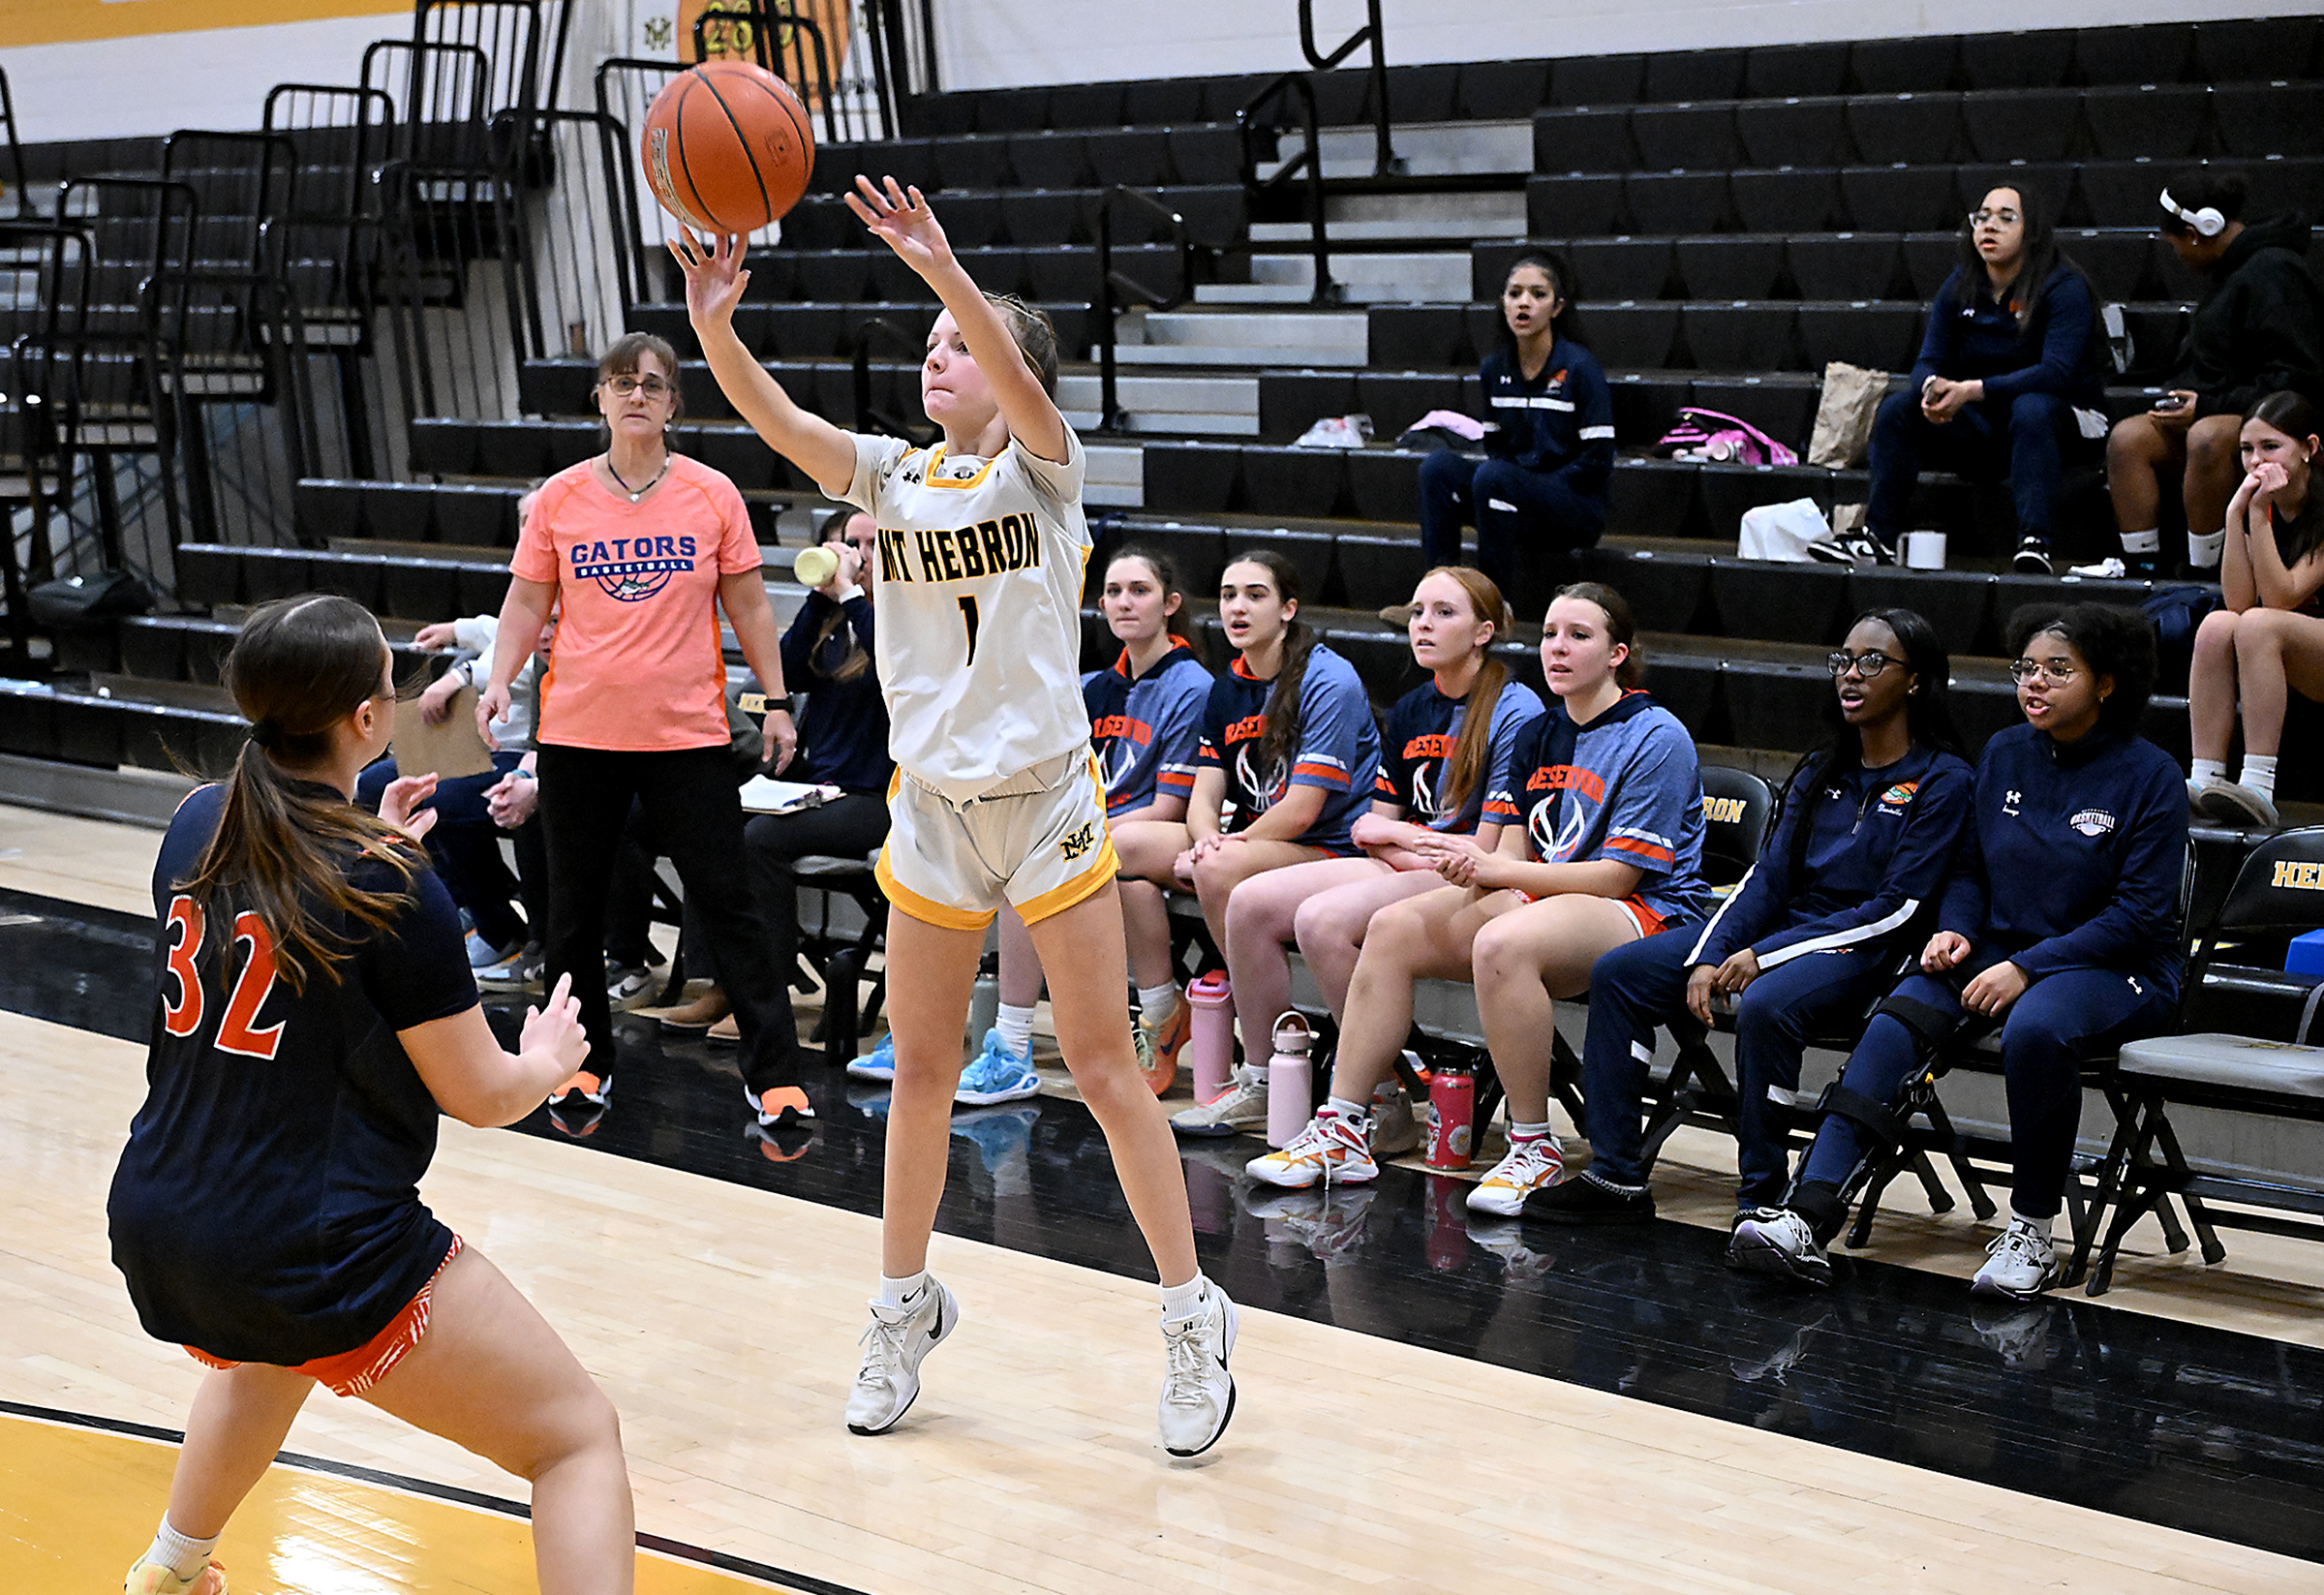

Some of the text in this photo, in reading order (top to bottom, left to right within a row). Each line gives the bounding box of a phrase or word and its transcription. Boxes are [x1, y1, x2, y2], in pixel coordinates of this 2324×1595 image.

[571, 537, 696, 564] GATORS
[580, 561, 688, 576] BASKETBALL
[877, 512, 1041, 583] MT HEBRON
[957, 595, 981, 666] 1
[1526, 764, 1605, 806] RESERVOIR
[2070, 812, 2116, 829] BASKETBALL
[161, 894, 287, 1061] 32
